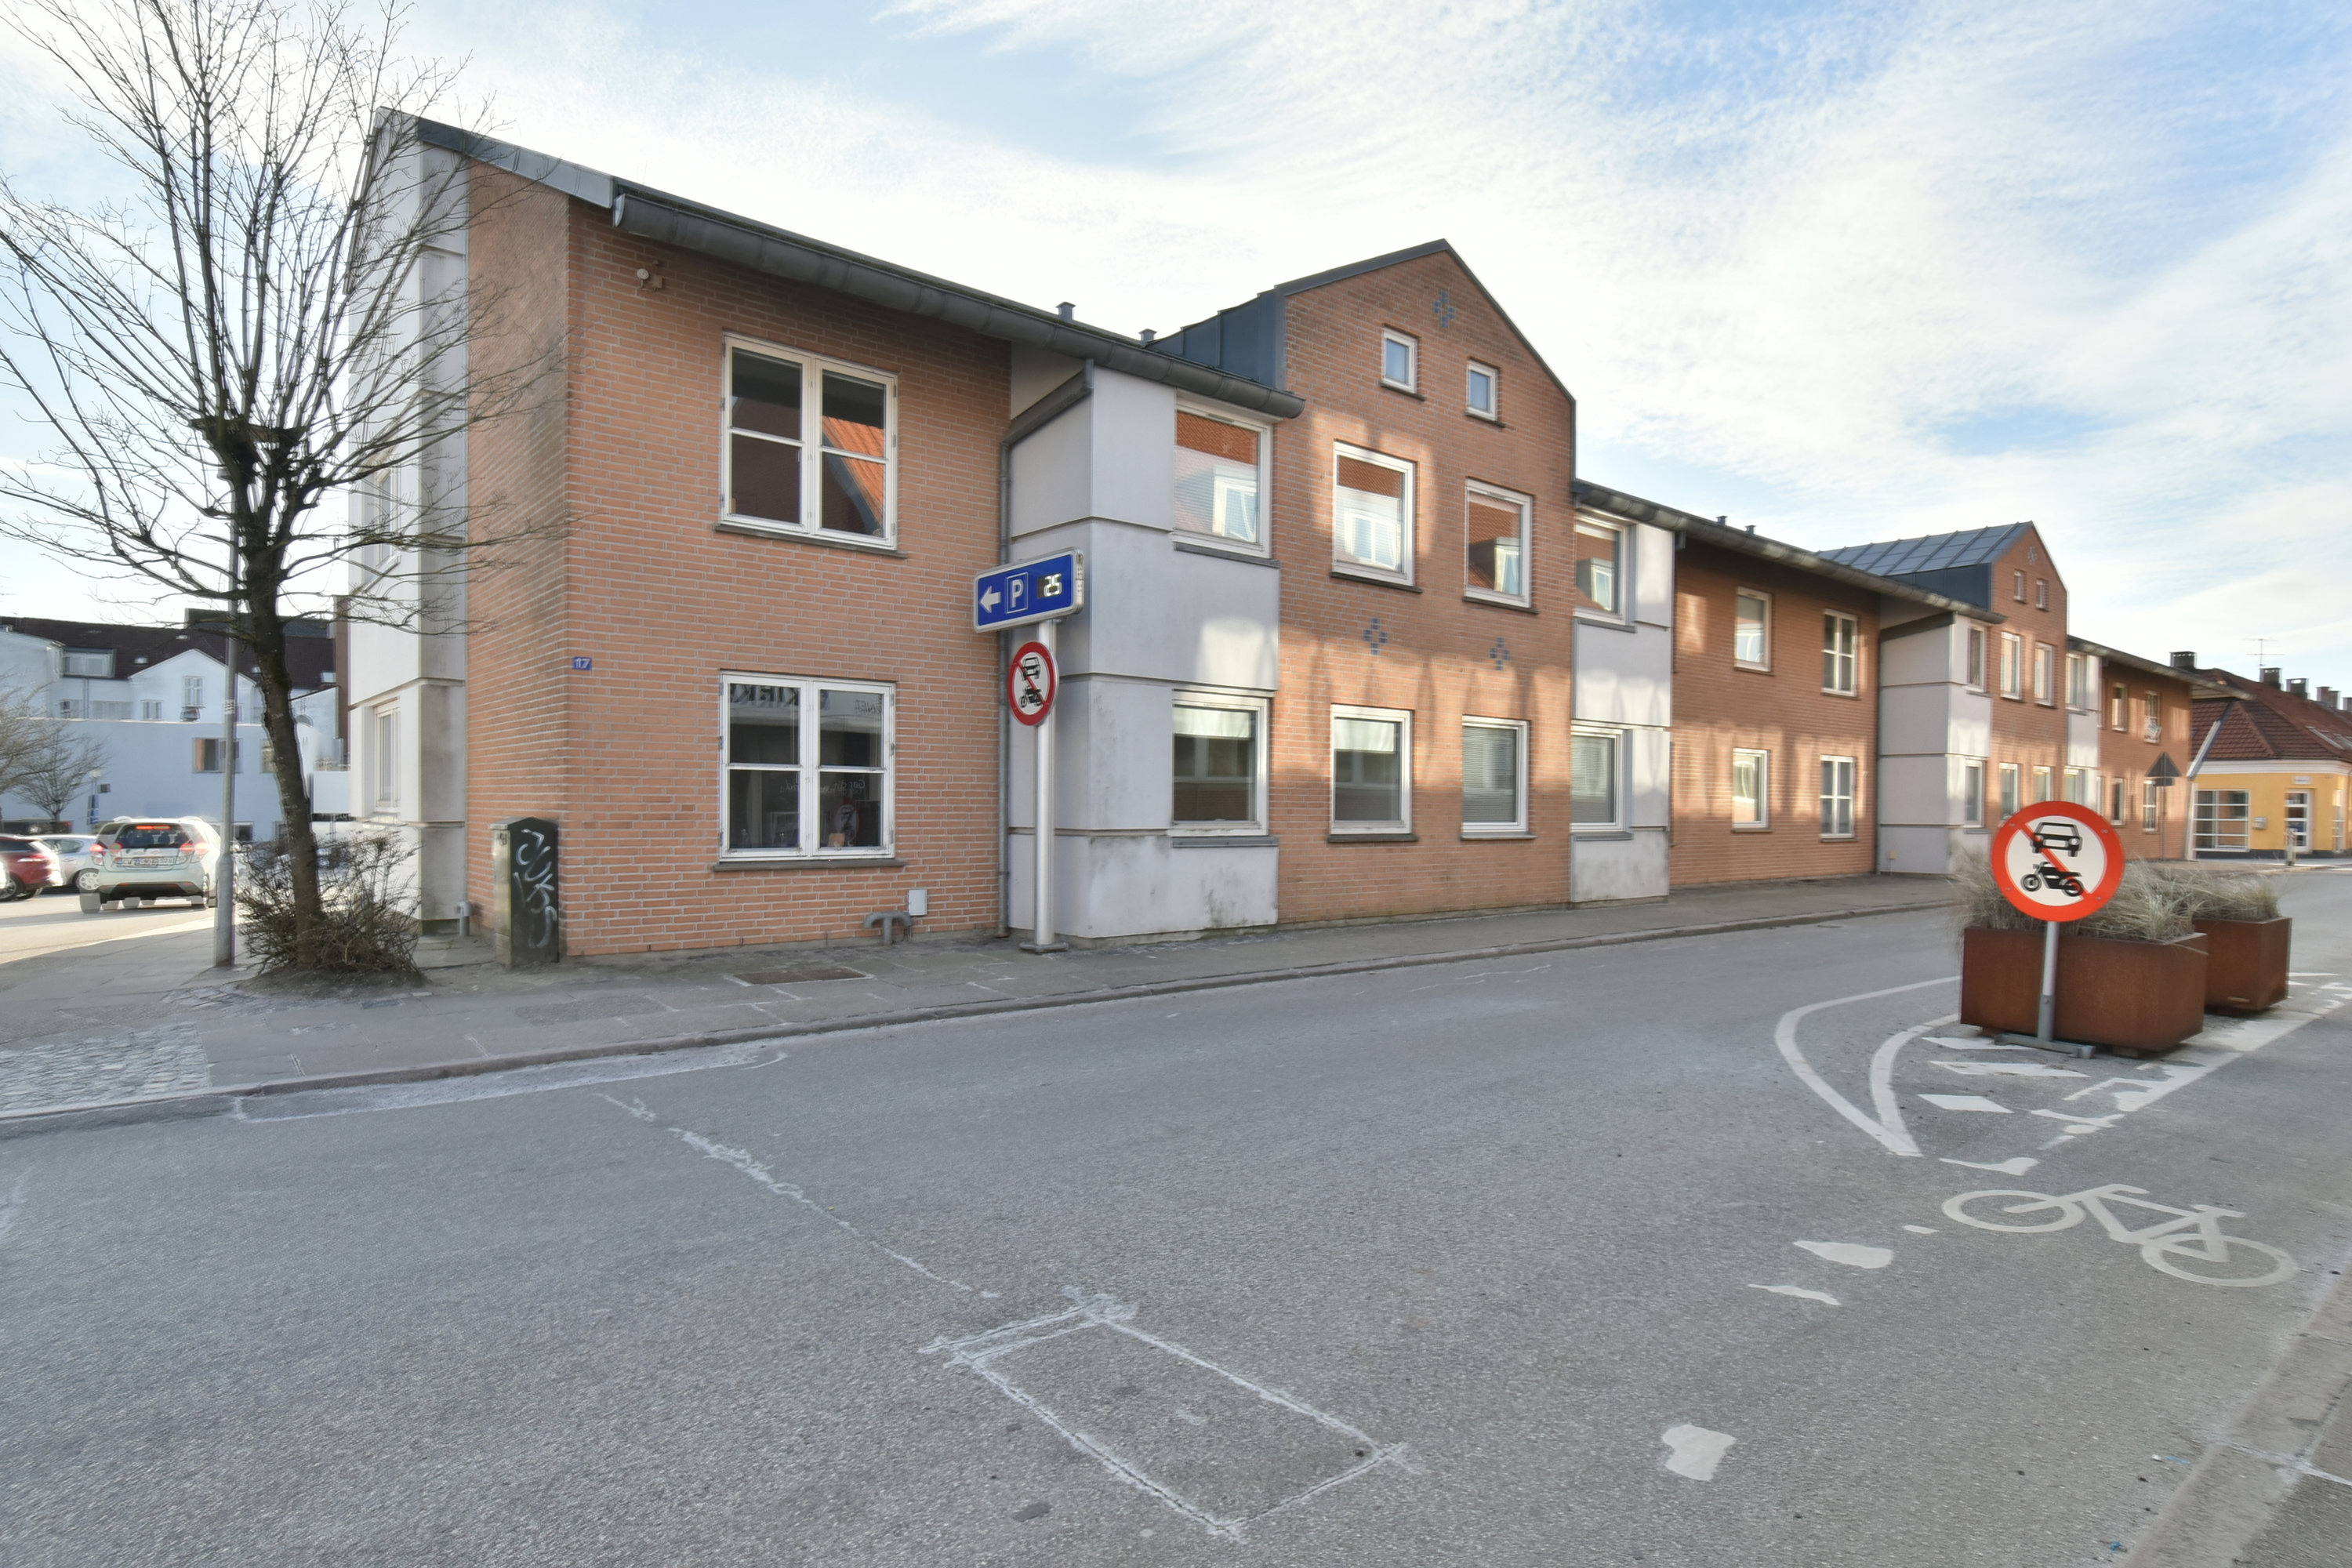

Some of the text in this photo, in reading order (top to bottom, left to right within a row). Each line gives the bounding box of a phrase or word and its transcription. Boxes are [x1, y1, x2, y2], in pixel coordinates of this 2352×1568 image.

[1011, 573, 1062, 608] P 25
[574, 658, 590, 669] 17
